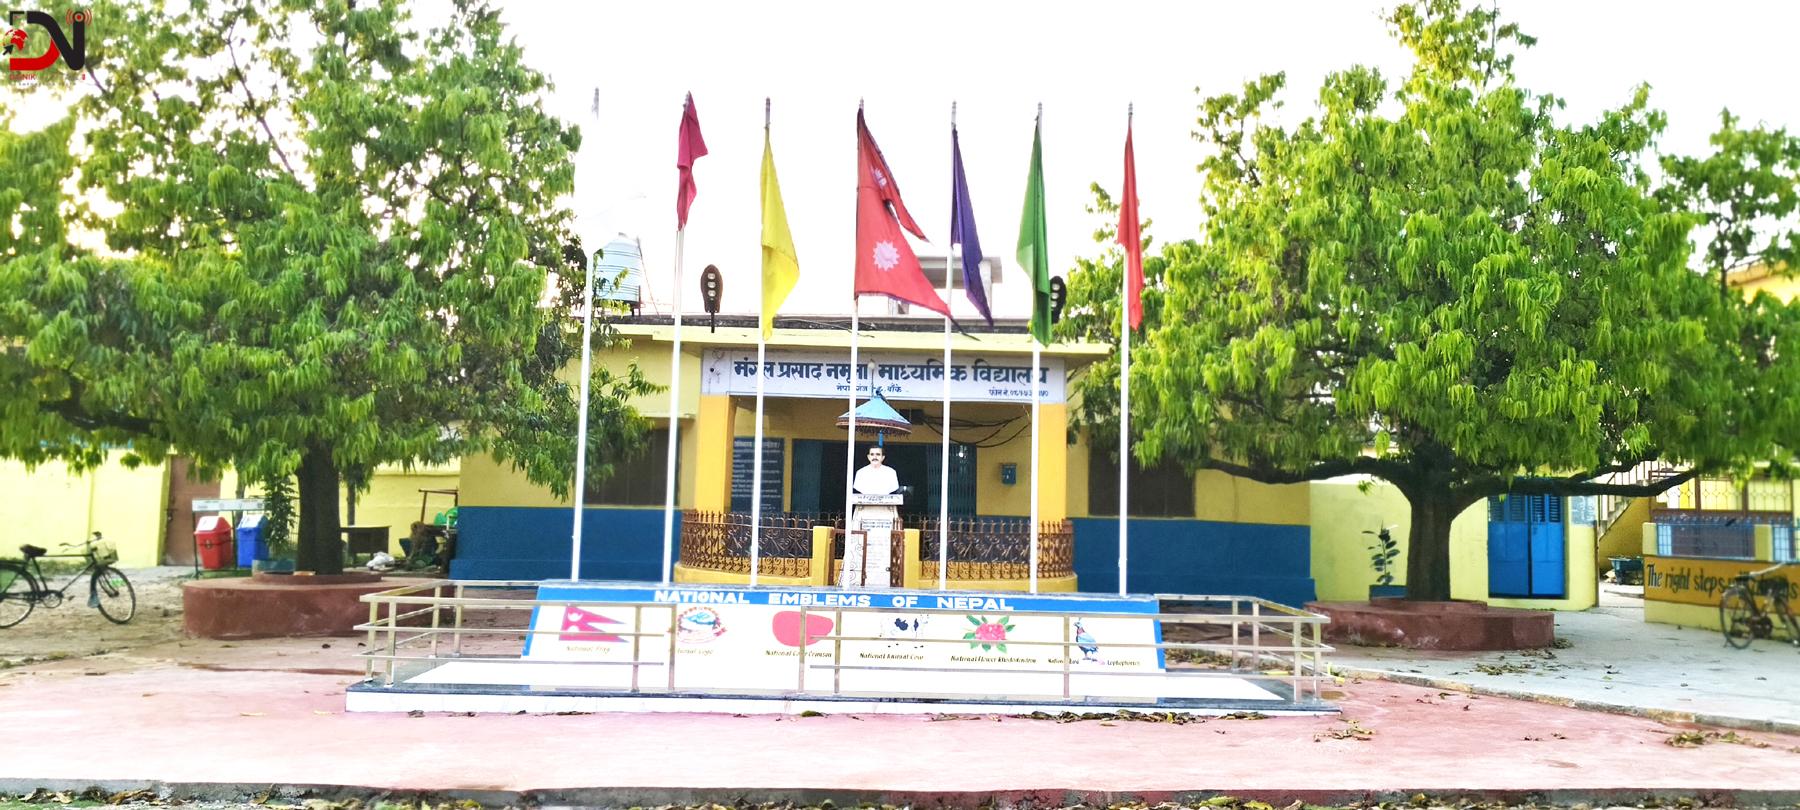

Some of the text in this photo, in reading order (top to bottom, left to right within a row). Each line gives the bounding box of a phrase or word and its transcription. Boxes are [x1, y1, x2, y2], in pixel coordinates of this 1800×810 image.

[734, 356, 1049, 386] मंगल प्रसाद नमूना माध्यमिक विद्यालय
[836, 382, 868, 392] नेपागंज
[1647, 564, 1663, 588] The
[1665, 566, 1690, 593] right
[1693, 568, 1728, 598] steps
[654, 590, 1014, 612] NATIONAL EMBLEMS OF NEPAL
